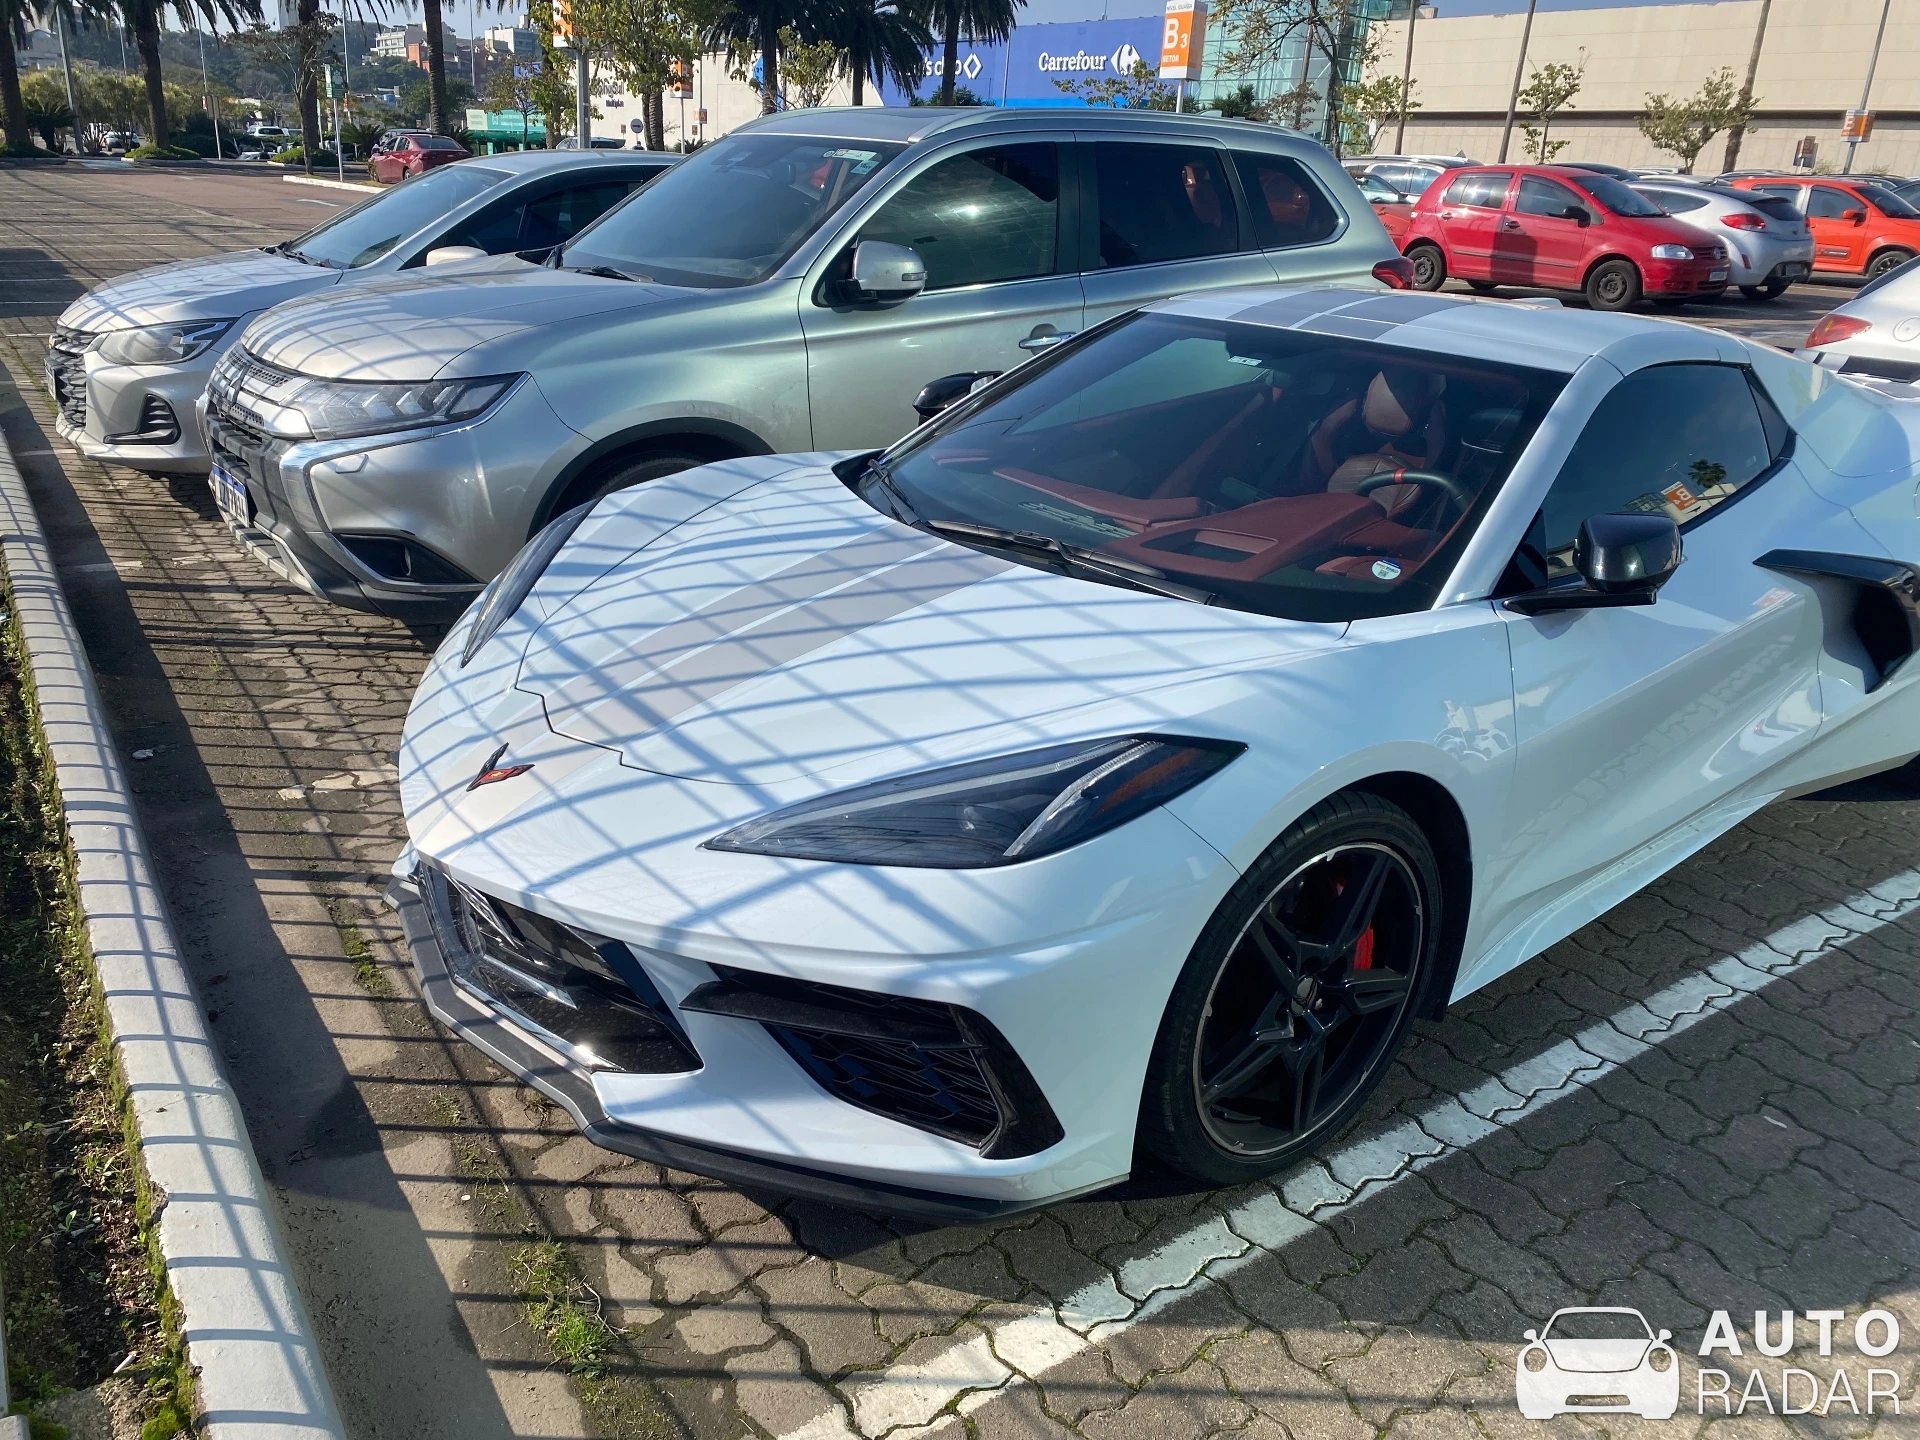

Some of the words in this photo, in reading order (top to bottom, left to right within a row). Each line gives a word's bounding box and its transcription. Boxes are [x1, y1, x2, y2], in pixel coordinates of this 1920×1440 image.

[1163, 18, 1180, 49] B
[1180, 32, 1189, 49] 3
[1038, 50, 1107, 72] Carrefour
